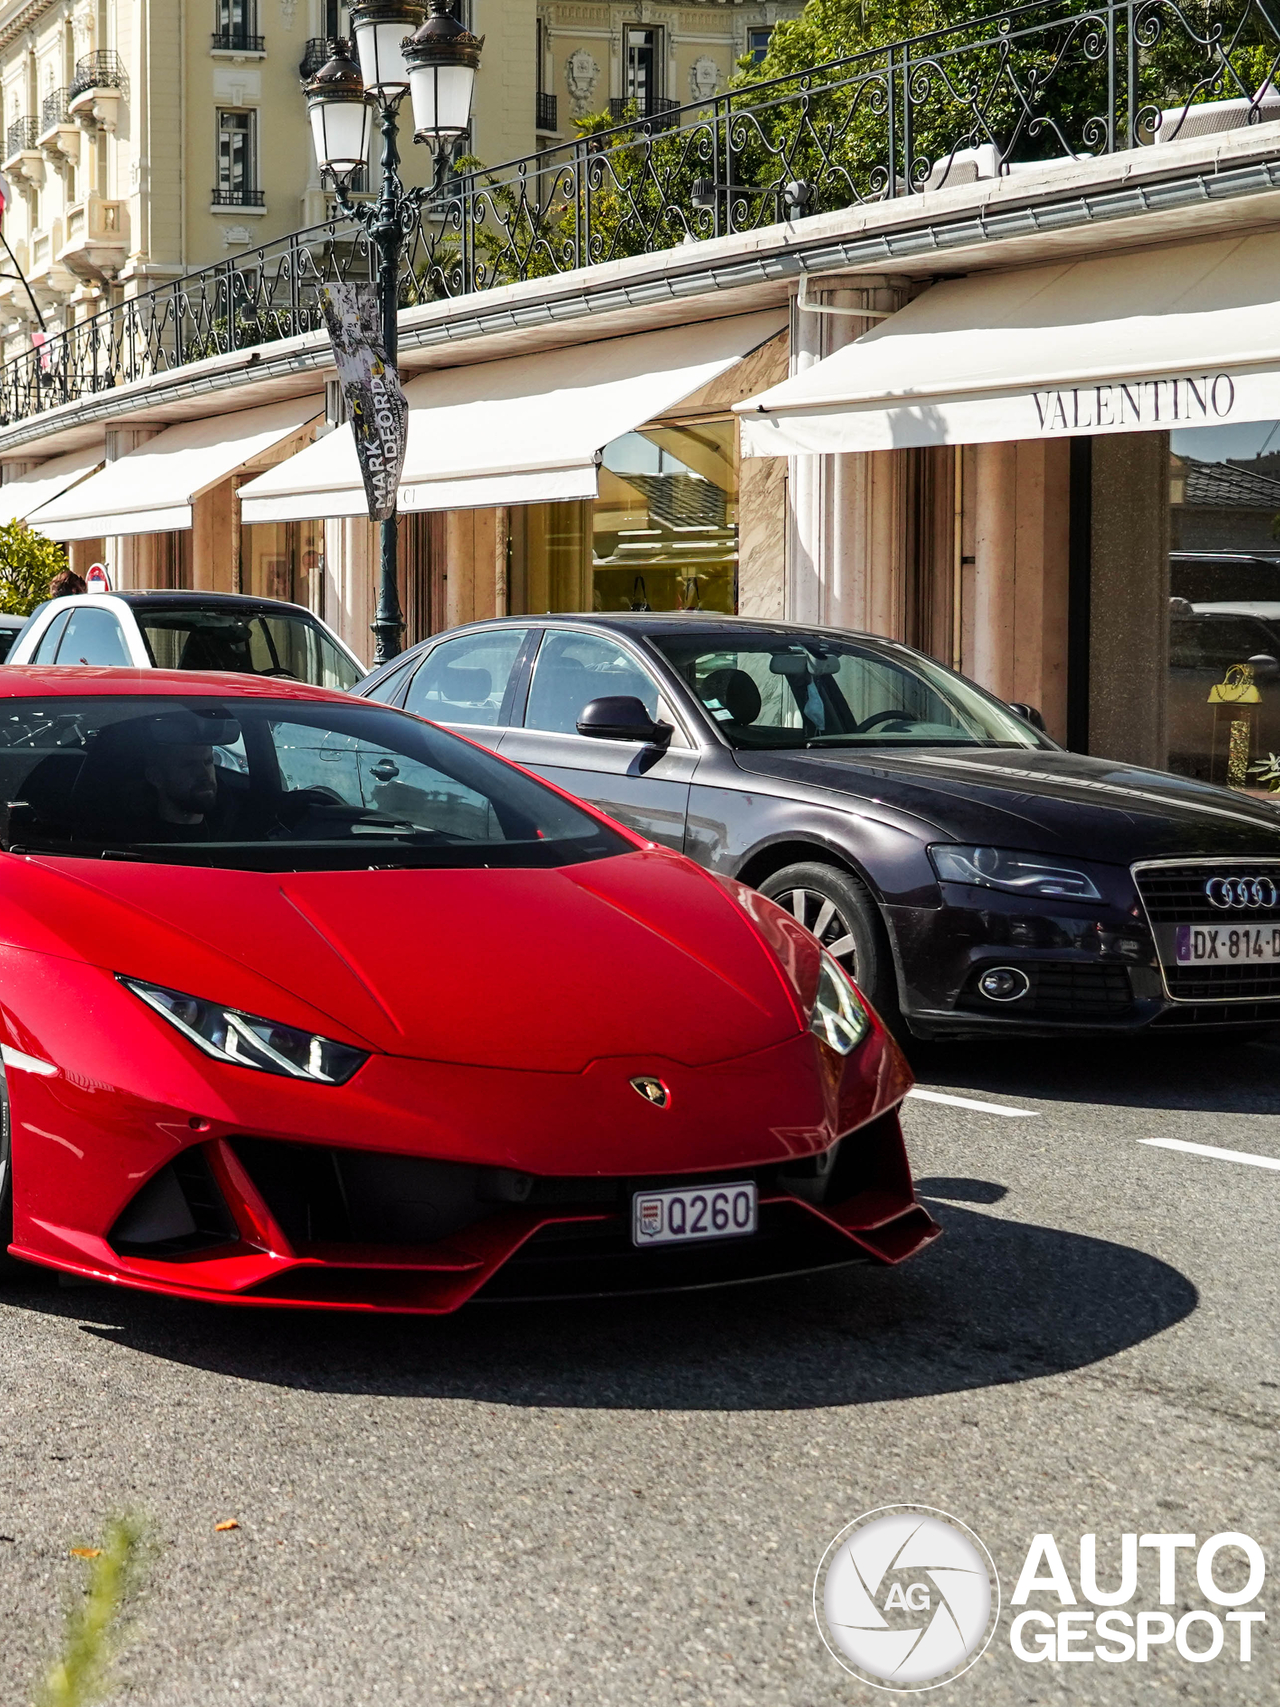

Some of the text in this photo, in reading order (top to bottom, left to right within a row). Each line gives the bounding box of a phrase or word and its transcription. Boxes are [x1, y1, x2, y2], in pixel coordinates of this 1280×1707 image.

[1031, 373, 1235, 430] VALENTINO
[364, 438, 386, 509] MARK
[371, 377, 398, 508] BRADFORD
[668, 1191, 750, 1236] Q260
